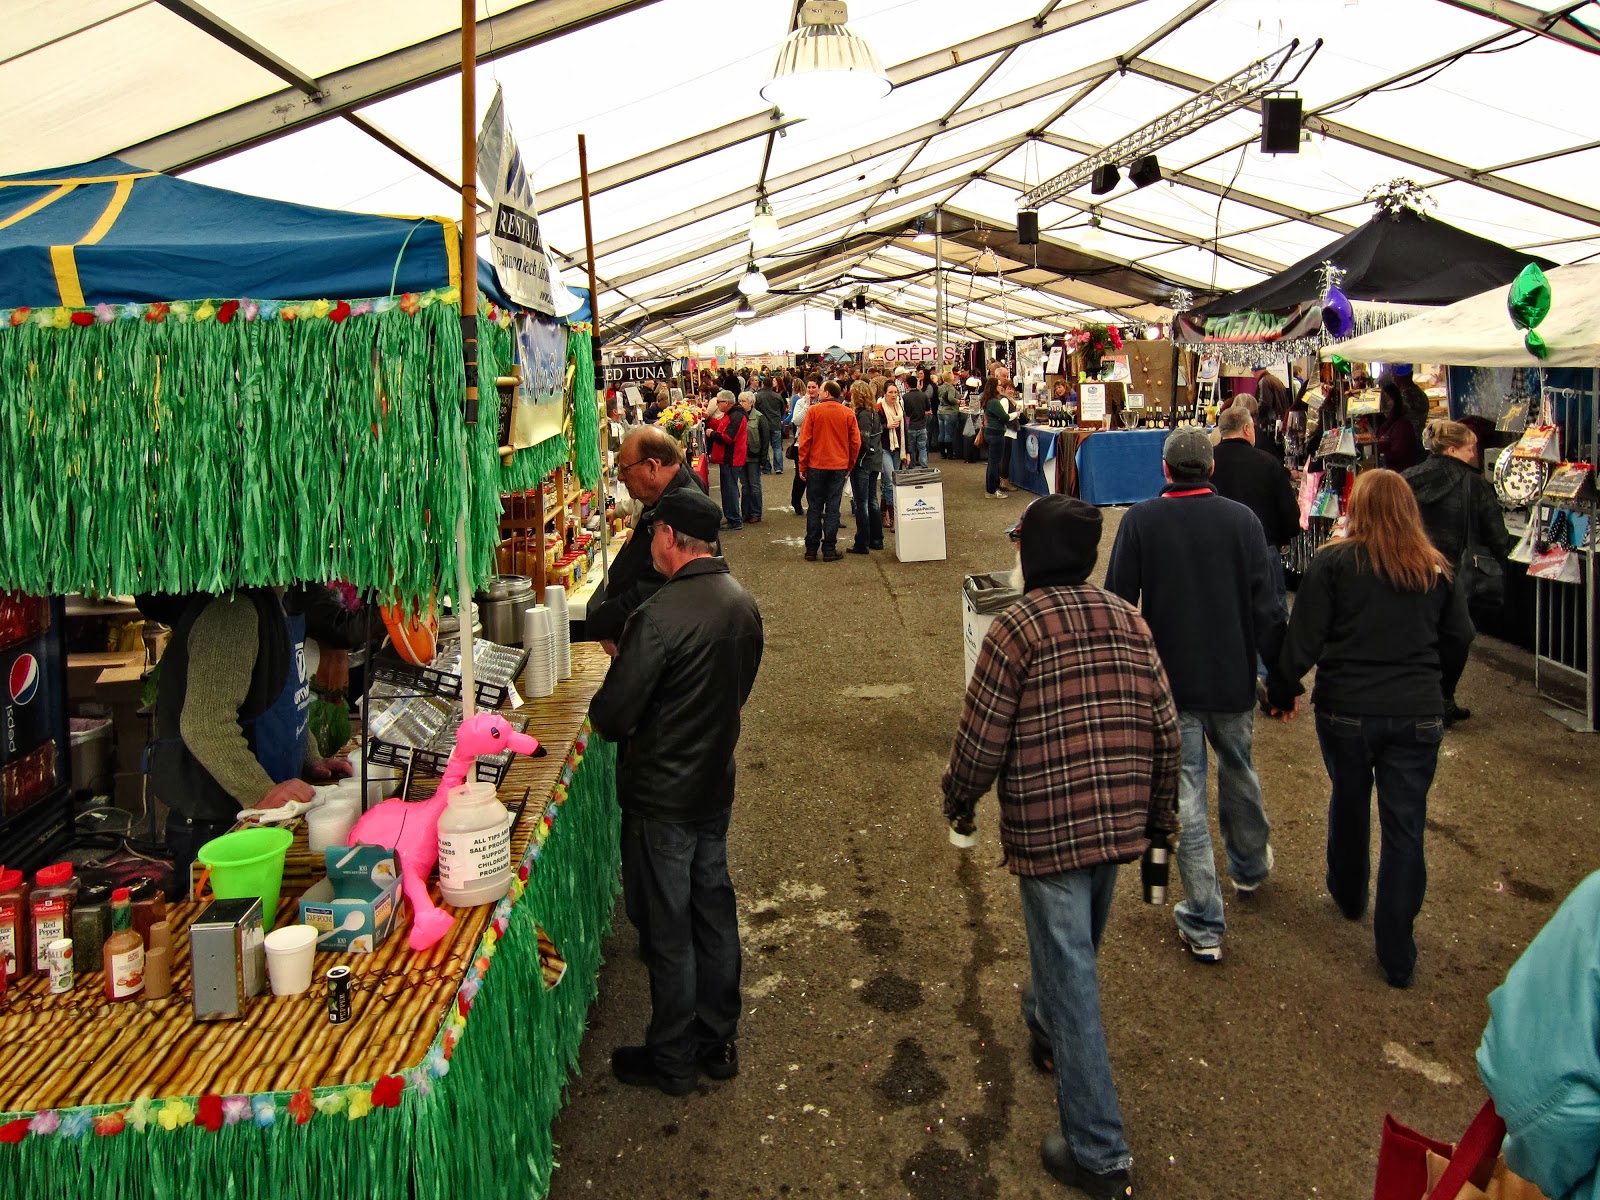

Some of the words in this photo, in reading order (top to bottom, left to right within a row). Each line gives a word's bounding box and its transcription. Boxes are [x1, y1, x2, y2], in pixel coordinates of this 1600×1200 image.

[627, 366, 666, 380] TUNA
[6, 705, 16, 752] pepsi
[488, 833, 500, 842] TIPS
[469, 846, 486, 854] SALE
[482, 846, 507, 860] SUPPORT
[479, 862, 509, 877] PROGRAMS
[43, 921, 56, 929] Red
[38, 928, 61, 936] Pepper
